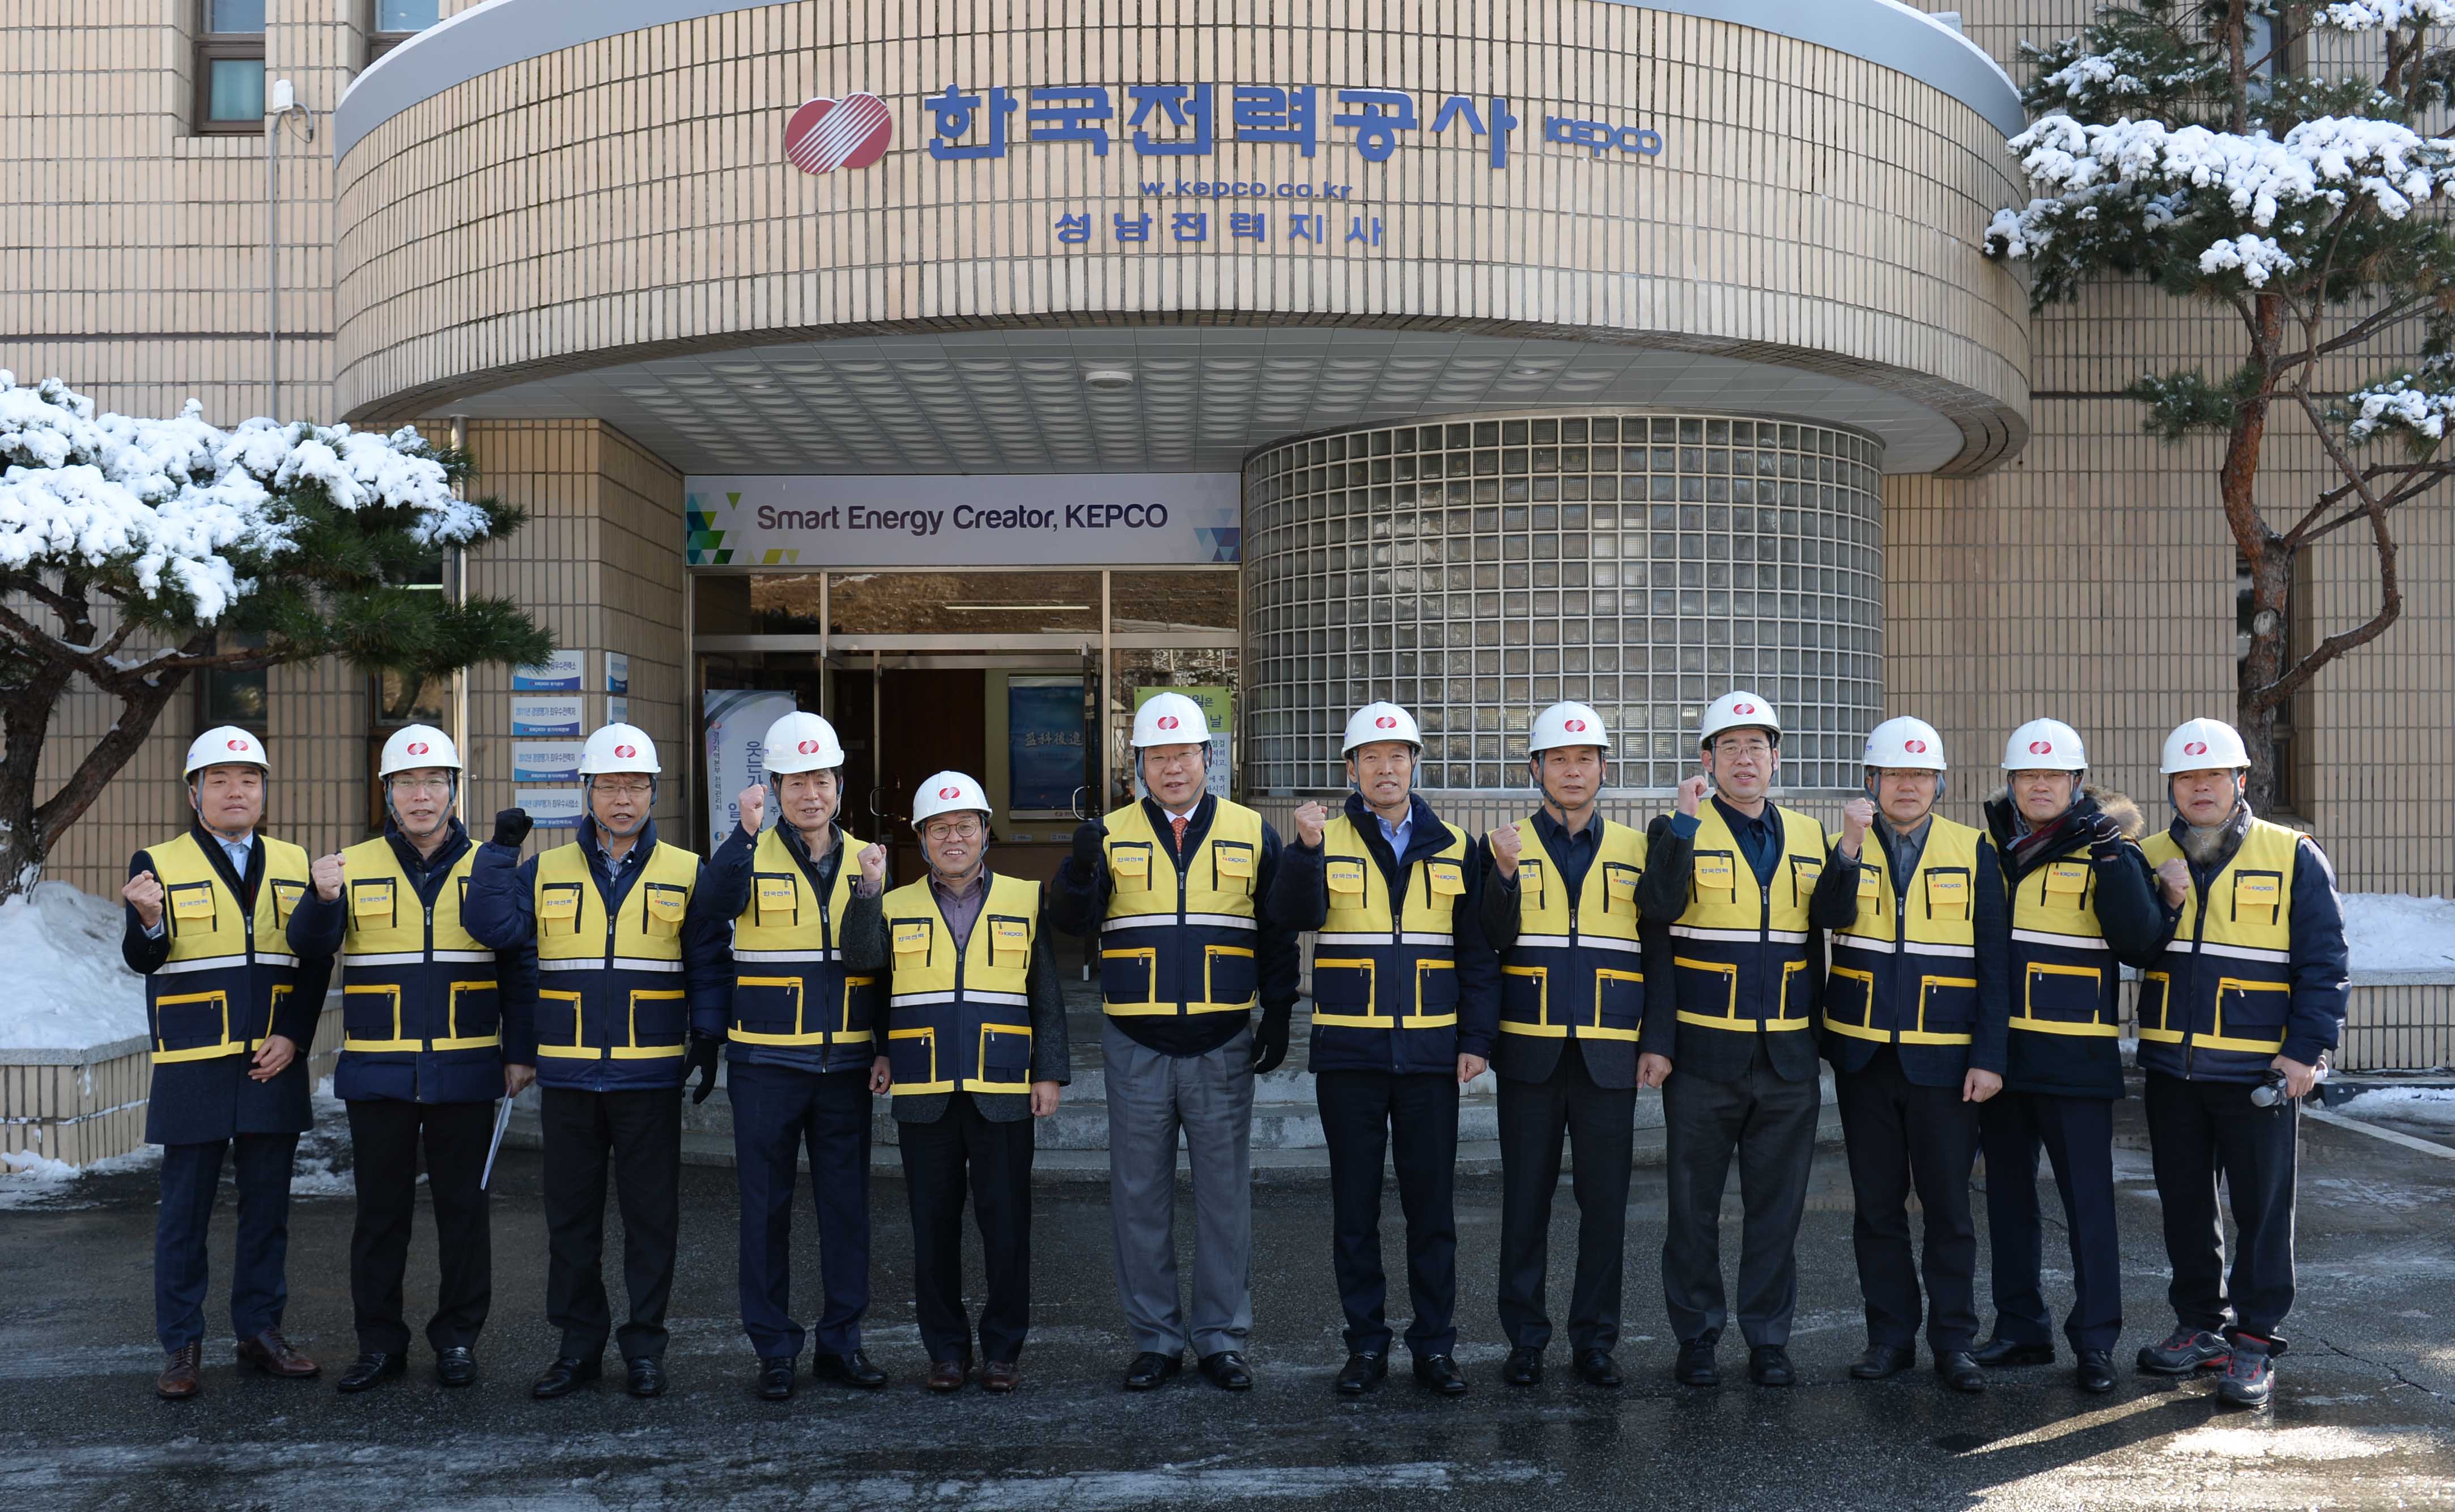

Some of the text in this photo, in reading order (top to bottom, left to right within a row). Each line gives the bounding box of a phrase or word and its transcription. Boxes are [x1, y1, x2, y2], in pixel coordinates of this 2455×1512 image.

[925, 84, 1518, 168] 한국전력공사
[1140, 178, 1353, 200] w.kepco.co.kr
[1055, 212, 1383, 246] 성남전력지사
[757, 503, 1168, 537] Smart Energy Creator, KEPCO
[1188, 694, 1213, 708] 일은
[1210, 715, 1222, 728] 날
